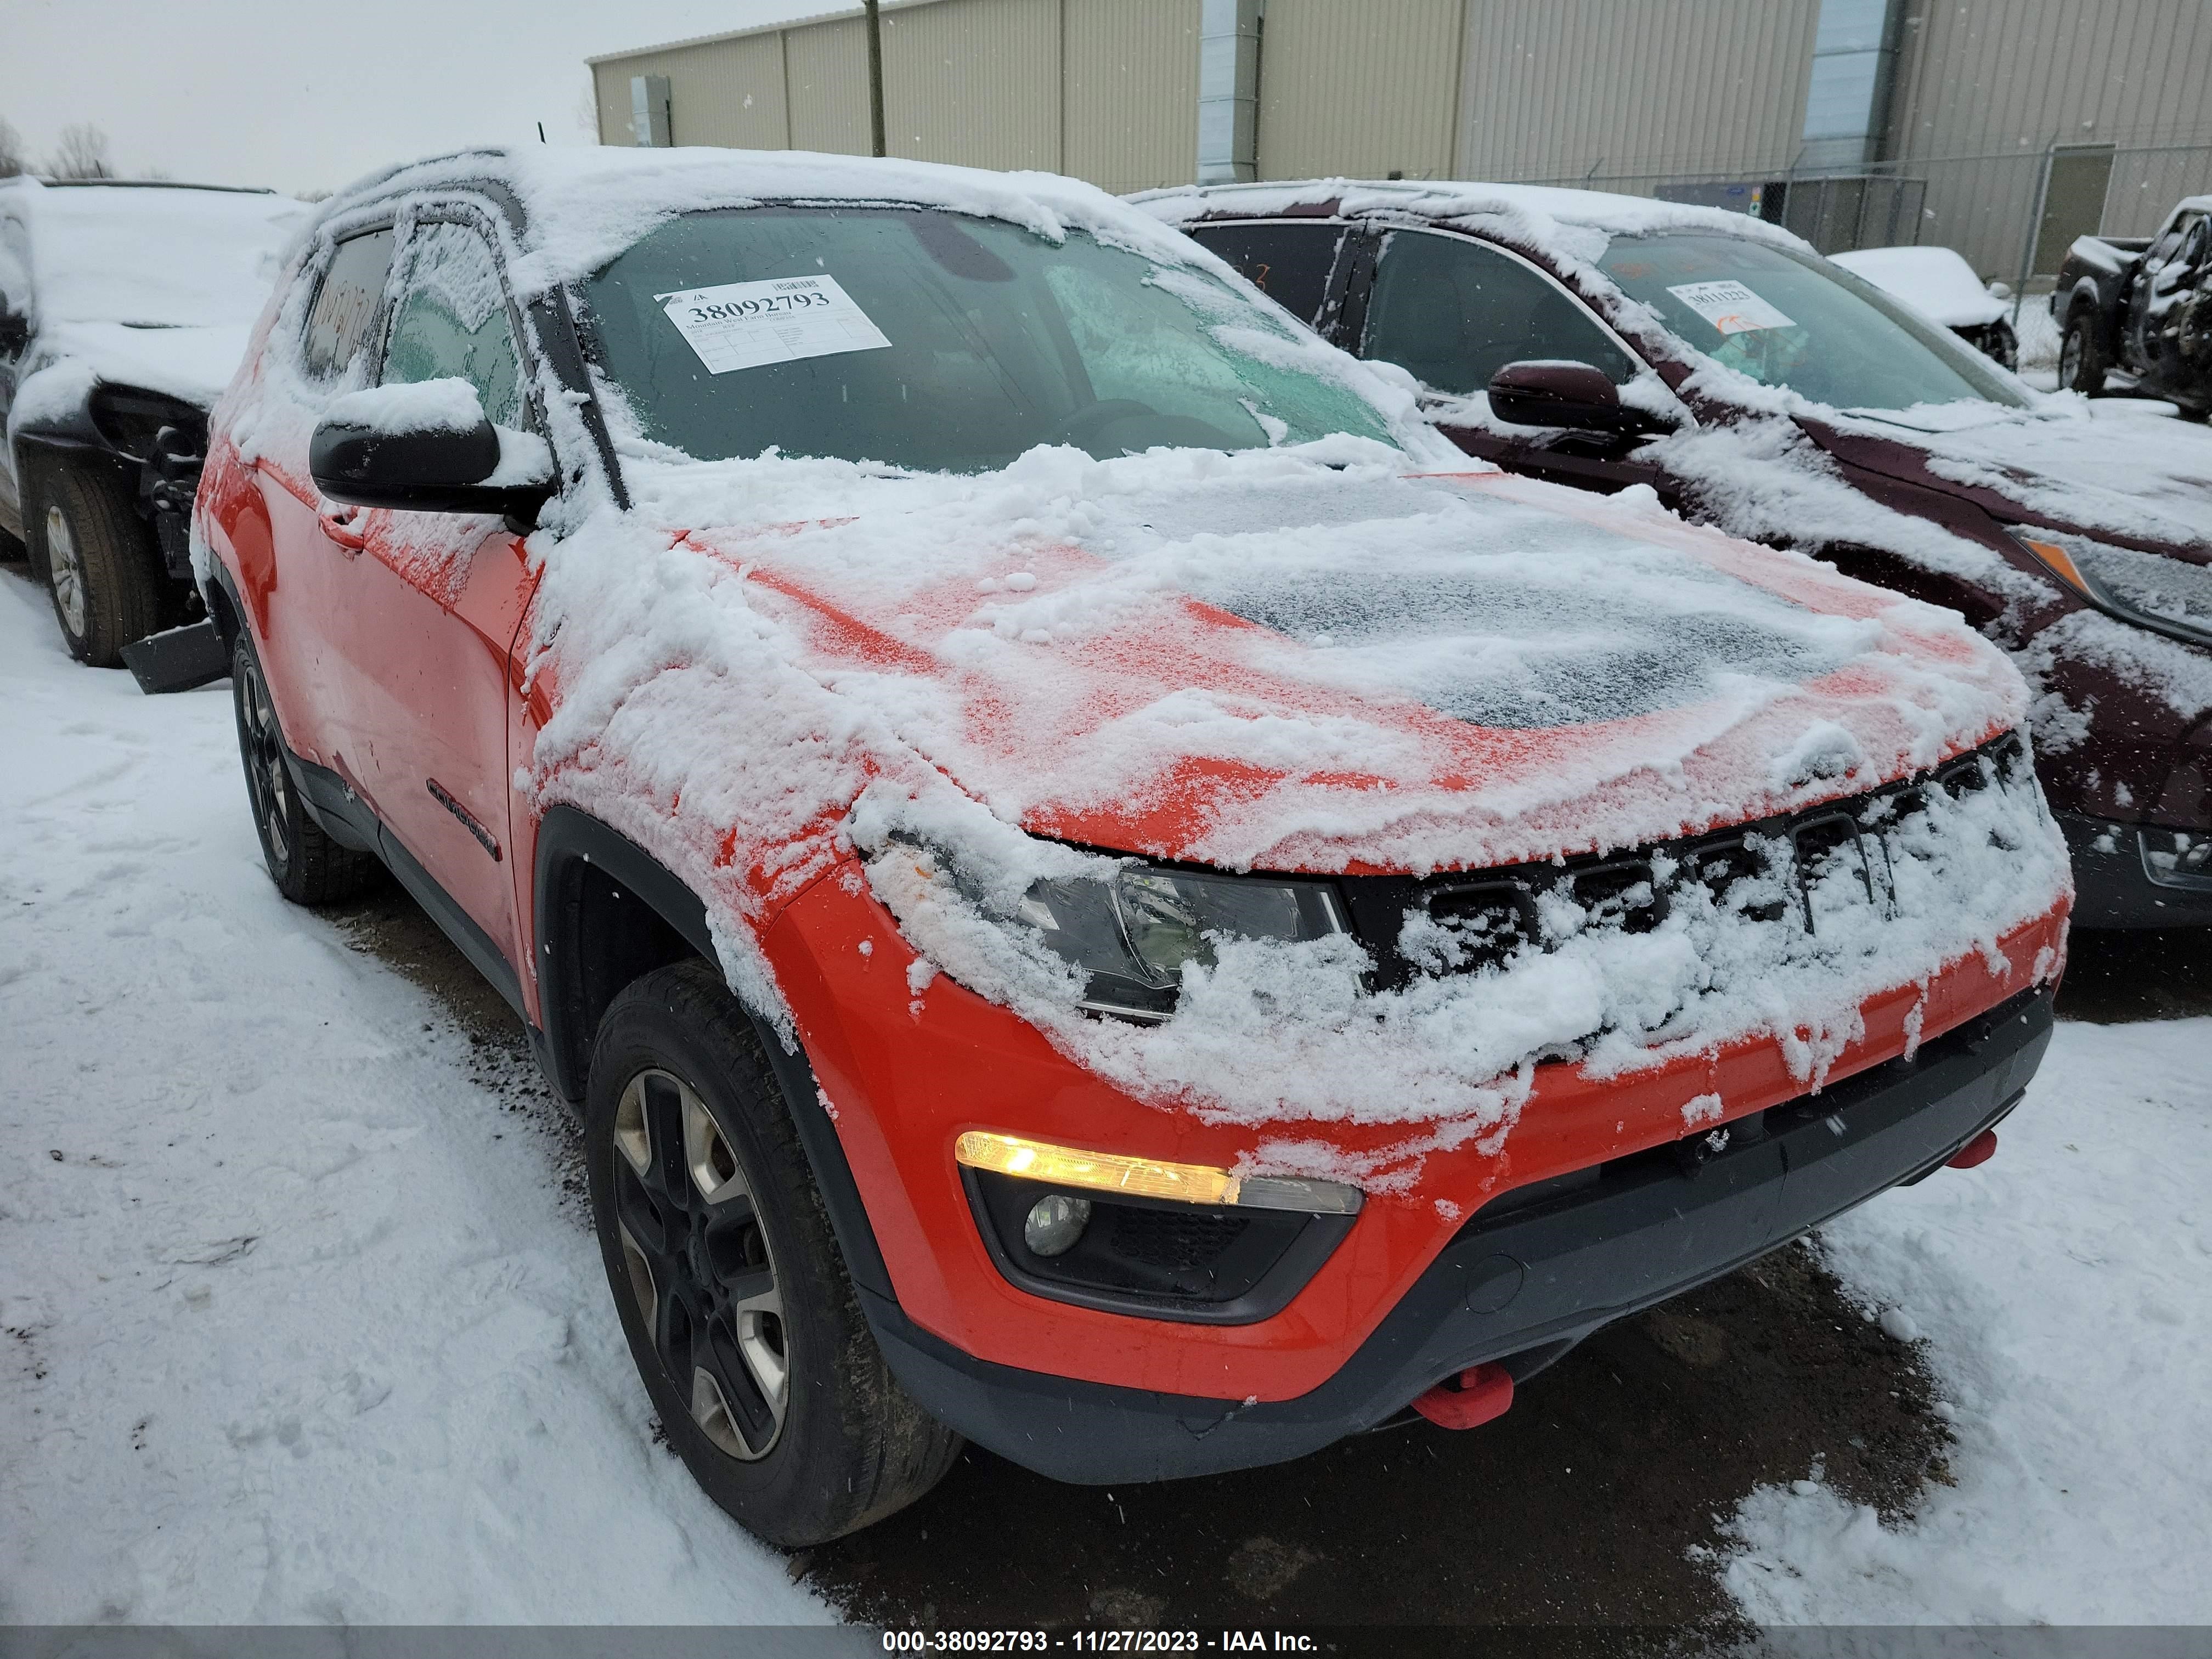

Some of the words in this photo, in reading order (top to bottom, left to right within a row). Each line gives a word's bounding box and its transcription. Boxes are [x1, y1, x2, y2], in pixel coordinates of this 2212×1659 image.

[1688, 290, 1751, 305] 38111223
[688, 292, 830, 323] 38092793
[686, 320, 723, 330] Mountain
[723, 315, 743, 324] West
